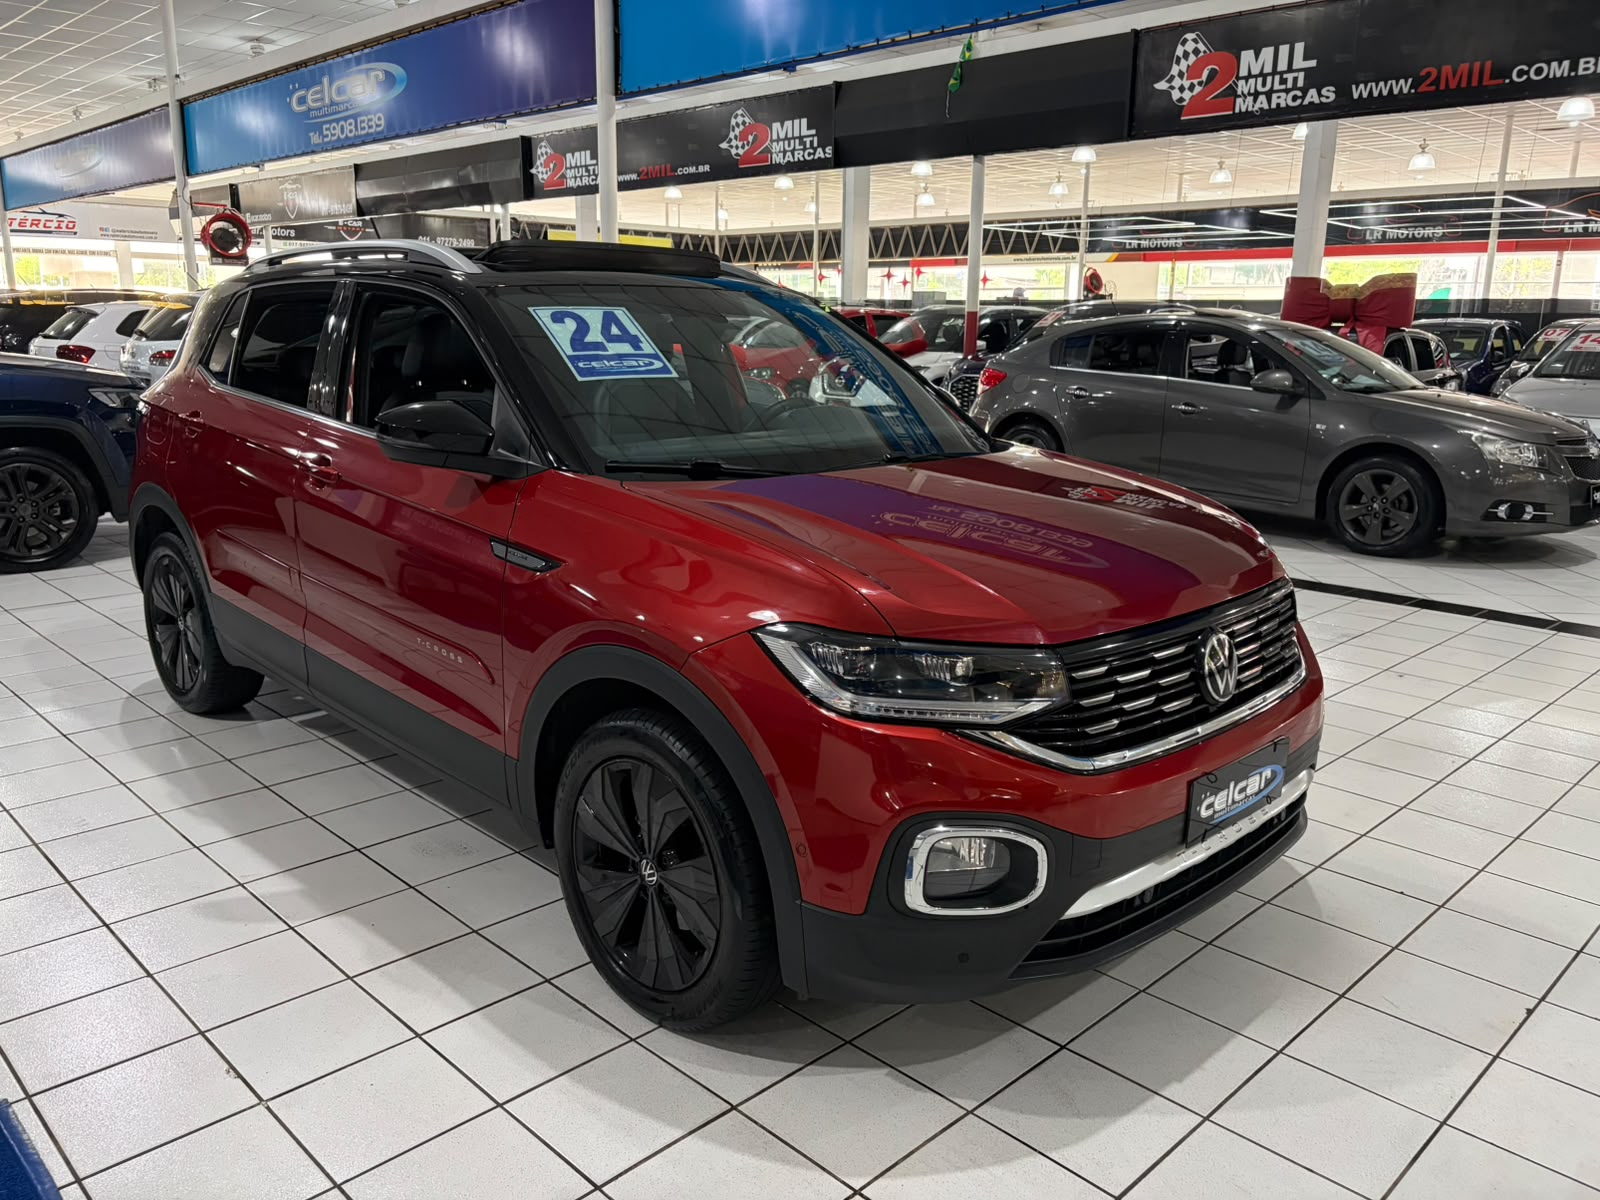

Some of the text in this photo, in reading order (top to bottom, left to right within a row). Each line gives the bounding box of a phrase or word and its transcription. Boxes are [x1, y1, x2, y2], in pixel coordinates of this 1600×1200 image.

[290, 67, 386, 112] celcar
[1181, 41, 1318, 120] 2 MIL
[1237, 71, 1305, 95] MULTI
[1235, 86, 1336, 115] MARCAS
[322, 112, 385, 143] 5908.1339
[738, 118, 816, 168] 2 MIL
[771, 146, 833, 165] MARCAS
[772, 136, 818, 153] MULTI
[544, 150, 597, 190] 2 MIL
[566, 165, 599, 178] MULTI
[8, 215, 77, 230] TÉRCIO
[1366, 225, 1444, 240] LR MOTORS
[1563, 220, 1585, 233] LR
[1125, 237, 1183, 249] LR MOTORS
[550, 310, 645, 353] 24
[578, 360, 650, 368] celcar
[416, 637, 463, 664] T-CROSS
[1197, 768, 1271, 818] celcar
